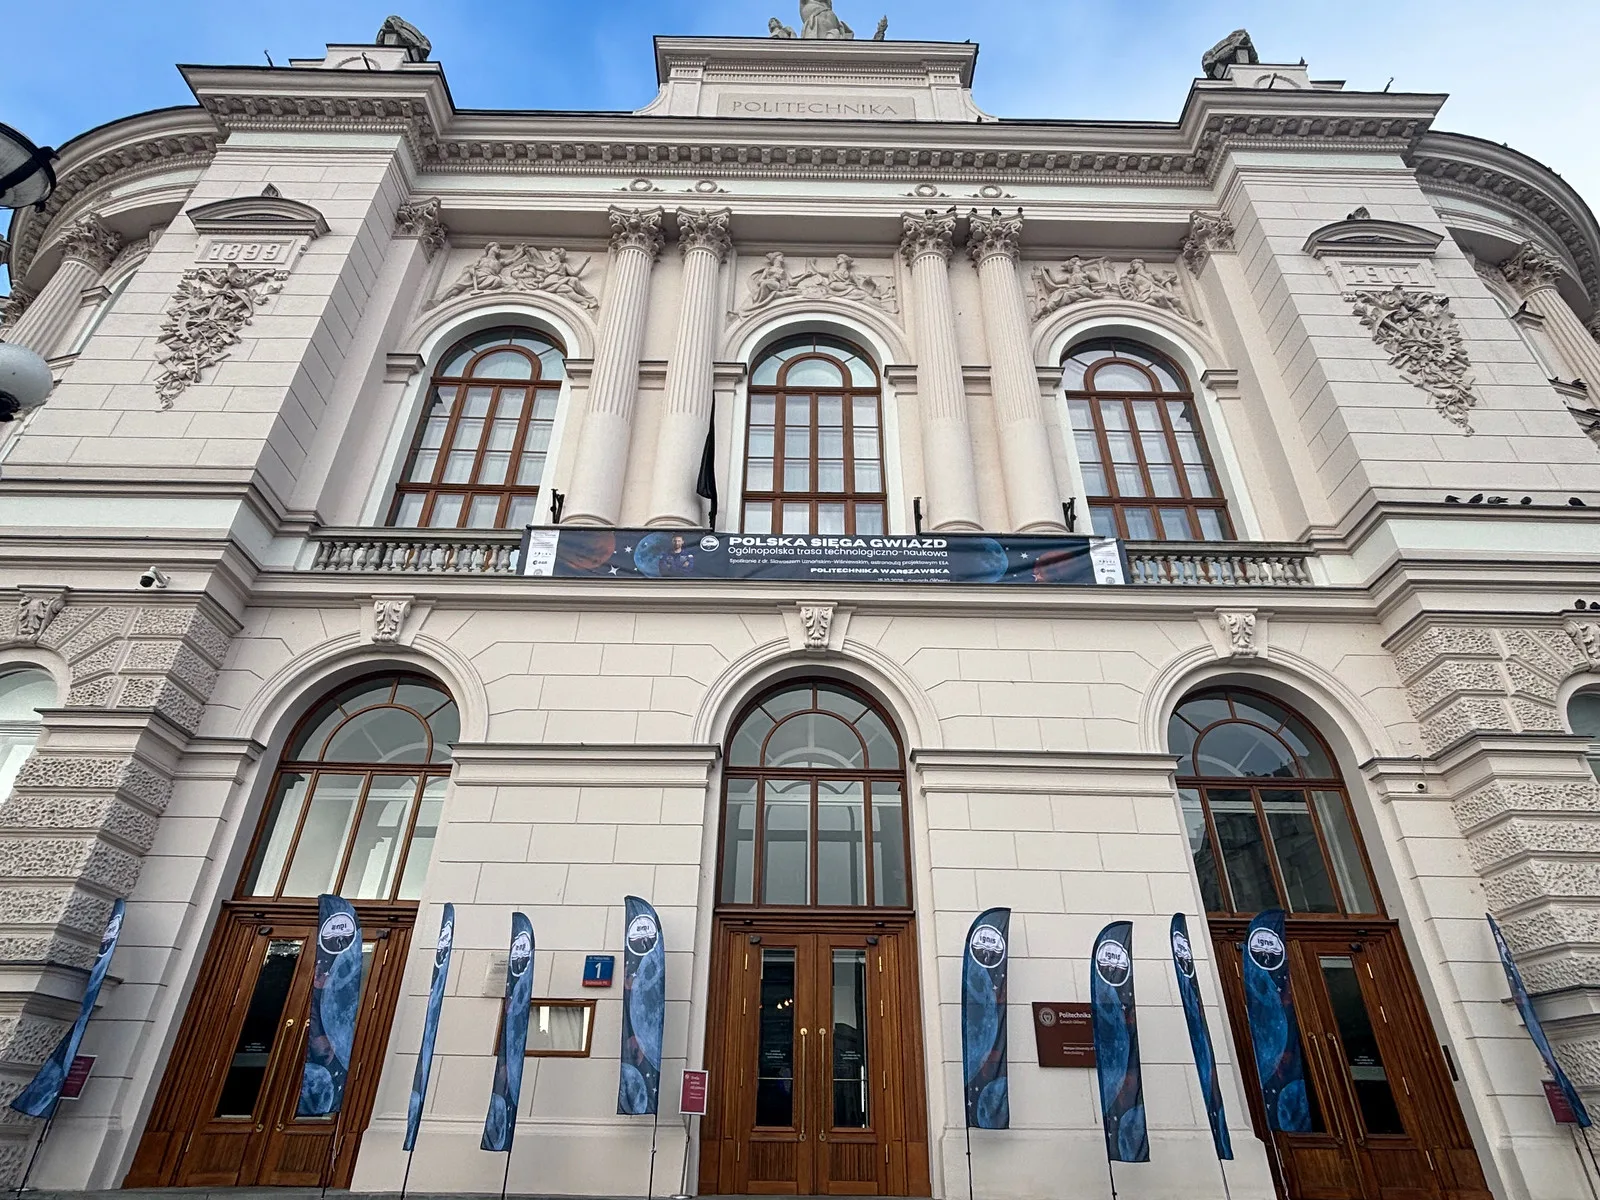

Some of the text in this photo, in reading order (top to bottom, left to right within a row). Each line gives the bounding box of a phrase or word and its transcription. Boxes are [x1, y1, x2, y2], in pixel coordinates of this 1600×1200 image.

[732, 101, 898, 115] POLITECHNIKA
[209, 243, 282, 261] 1899
[1348, 266, 1420, 284] 1901
[729, 537, 948, 549] POLSKA SIĘGA GWIAZD
[727, 546, 795, 557] Ogólnopolska
[824, 547, 948, 558] technologiczno-naukowa
[595, 962, 602, 979] 1
